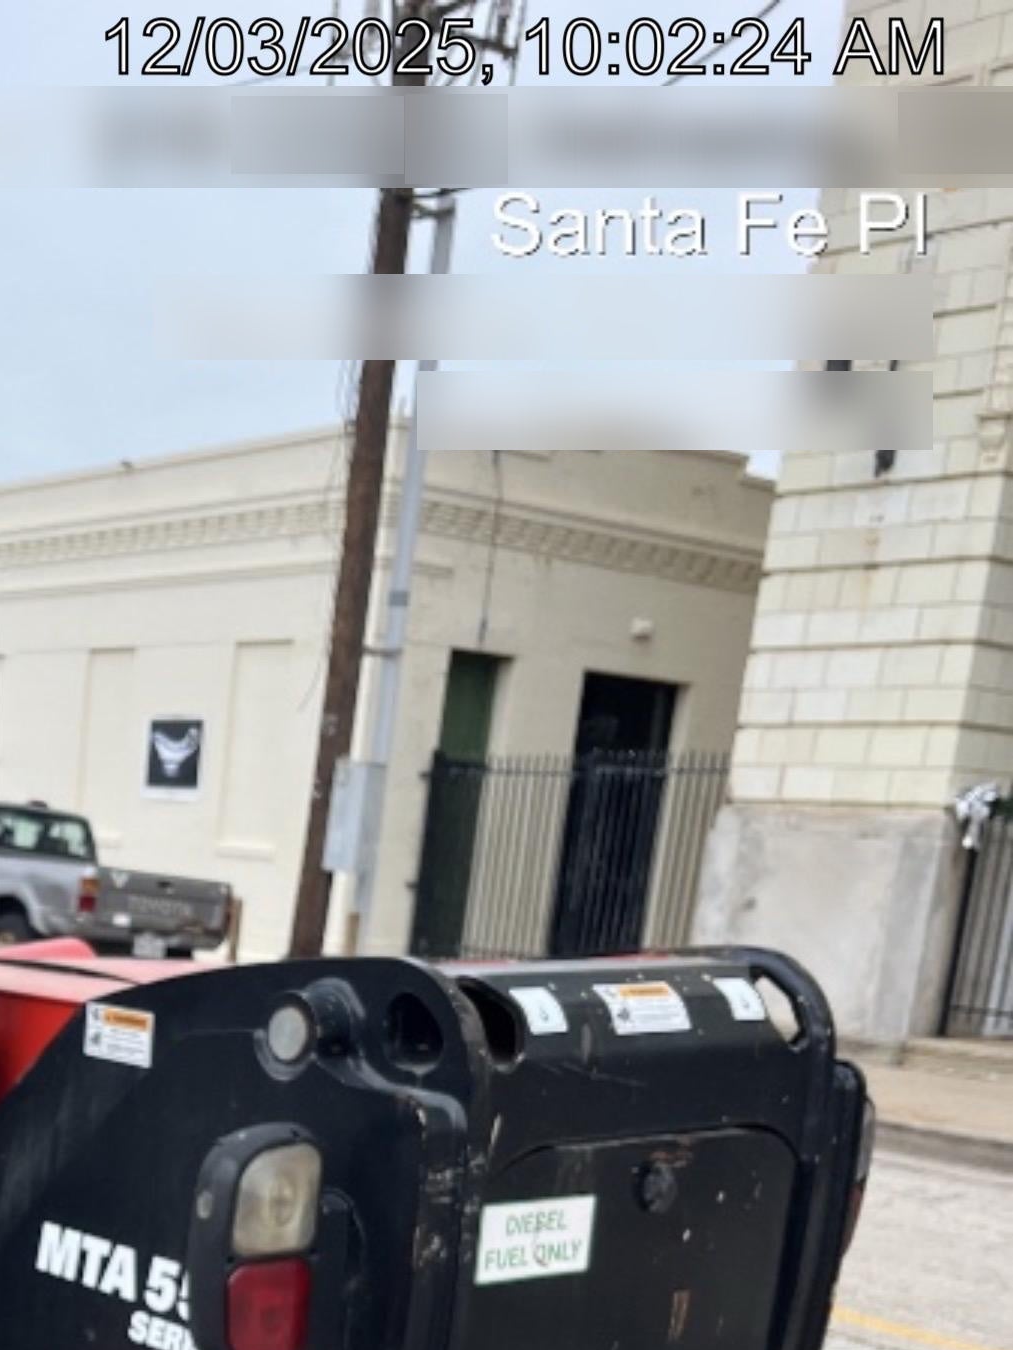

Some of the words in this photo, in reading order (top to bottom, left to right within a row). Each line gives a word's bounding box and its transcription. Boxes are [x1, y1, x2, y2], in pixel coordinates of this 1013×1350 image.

[505, 1208, 570, 1237] DIESEL
[35, 1220, 137, 1302] MTA
[484, 1245, 529, 1272] FUEL
[532, 1239, 582, 1268] ONLY
